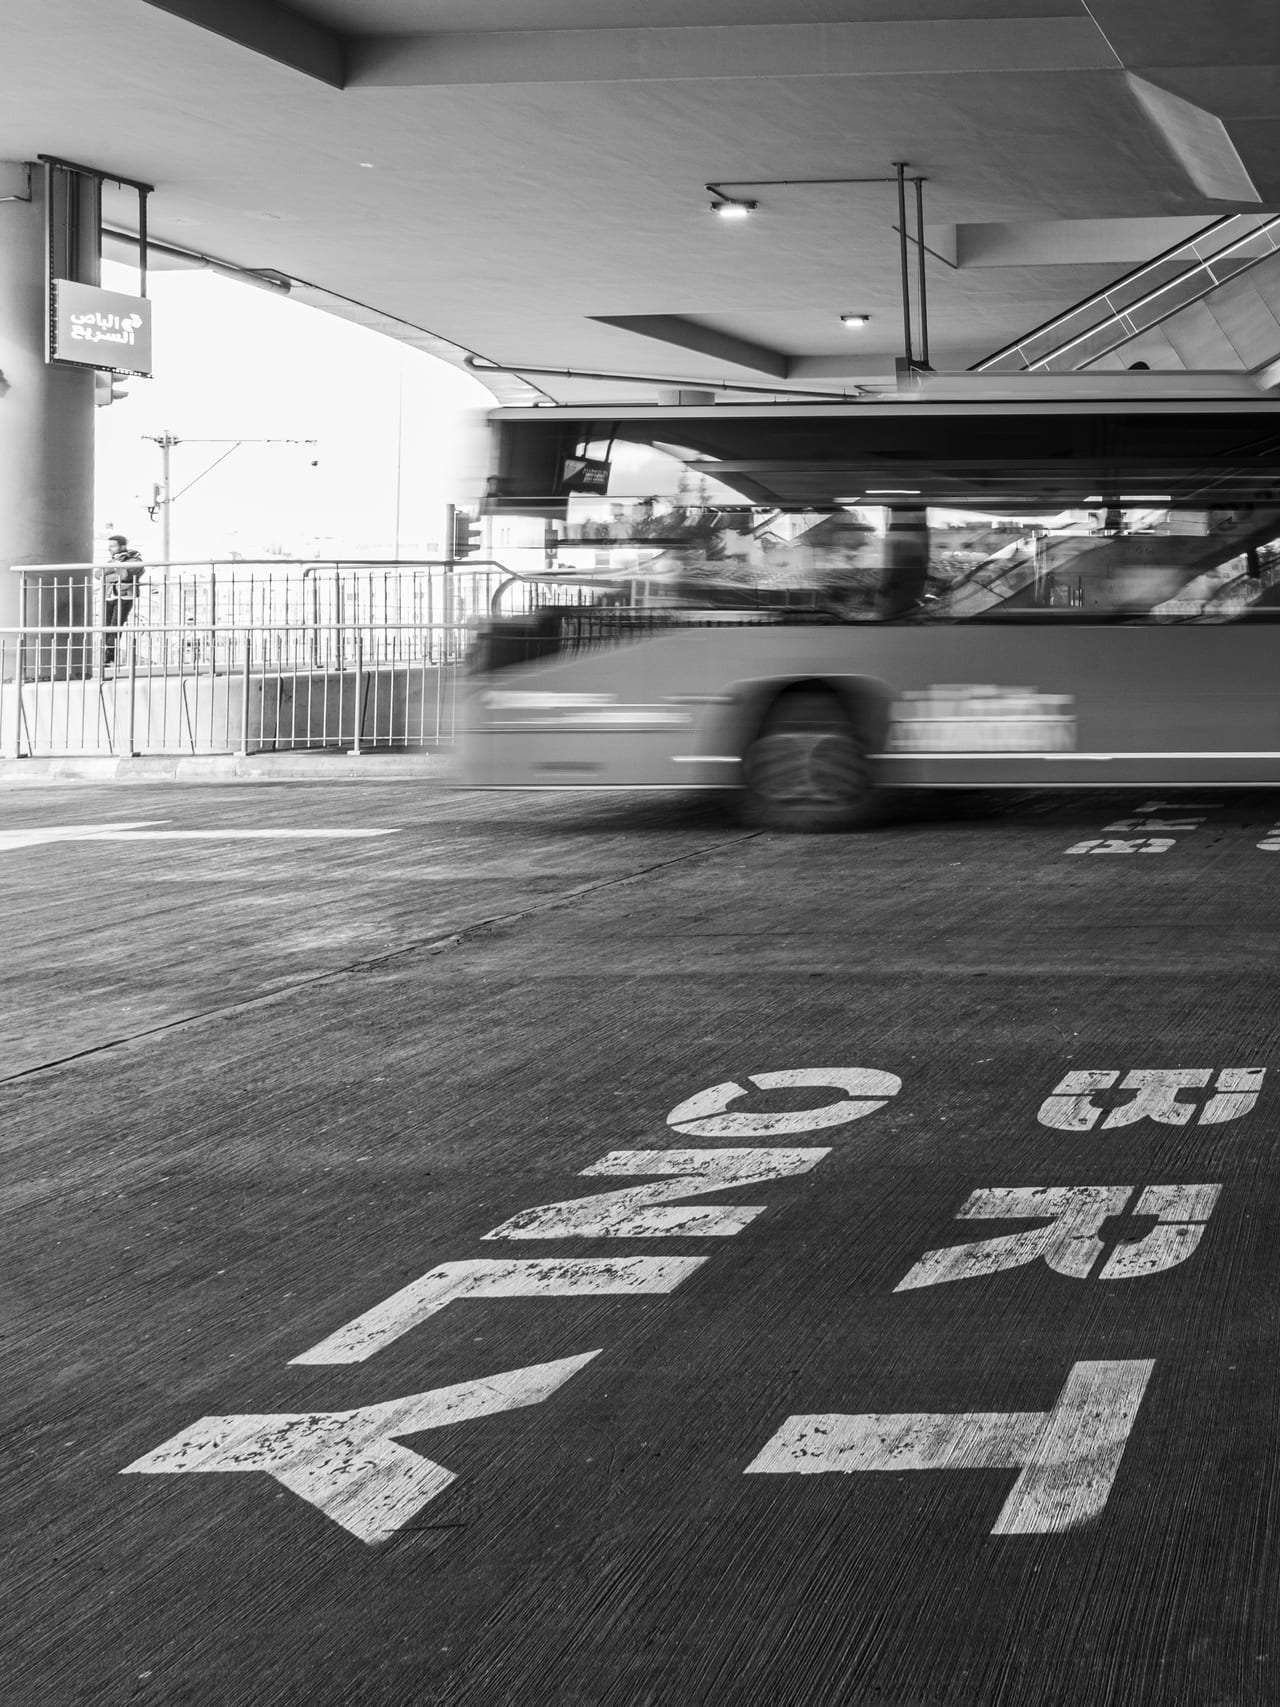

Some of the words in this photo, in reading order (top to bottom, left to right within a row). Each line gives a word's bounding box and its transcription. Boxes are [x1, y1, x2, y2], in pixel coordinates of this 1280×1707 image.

[71, 313, 119, 330] الباص
[72, 325, 134, 345] السريع
[1062, 800, 1225, 855] BRT
[119, 1066, 902, 1546] ONLY
[743, 1065, 1267, 1536] BRT
